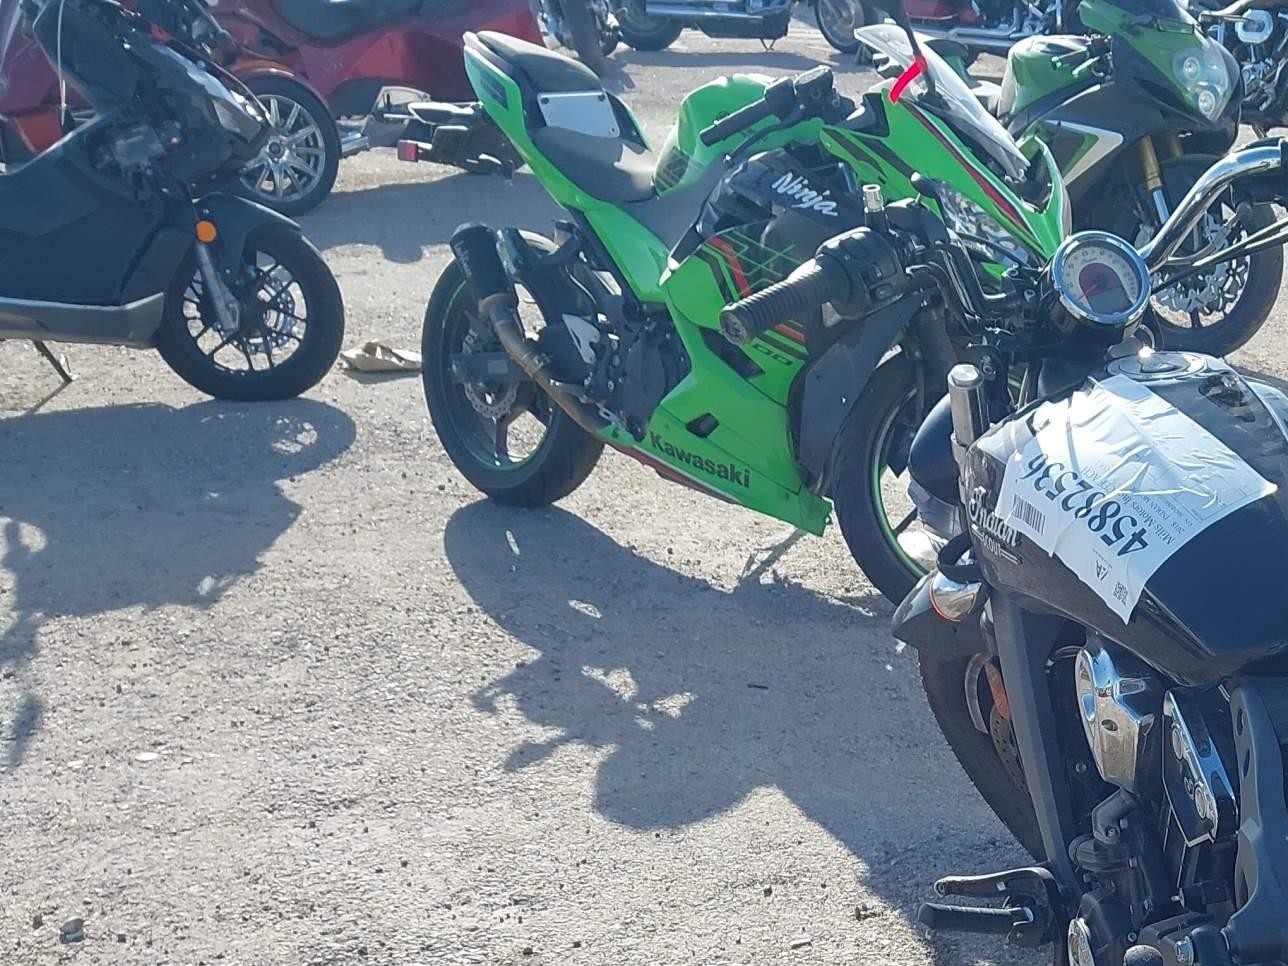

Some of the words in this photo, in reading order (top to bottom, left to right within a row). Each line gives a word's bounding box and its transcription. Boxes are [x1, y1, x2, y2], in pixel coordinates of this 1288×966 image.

[772, 172, 838, 217] Ninja
[752, 343, 794, 365] 00
[650, 431, 752, 488] Kawasaki
[969, 486, 1018, 547] Indian
[1020, 454, 1150, 557] 45882536
